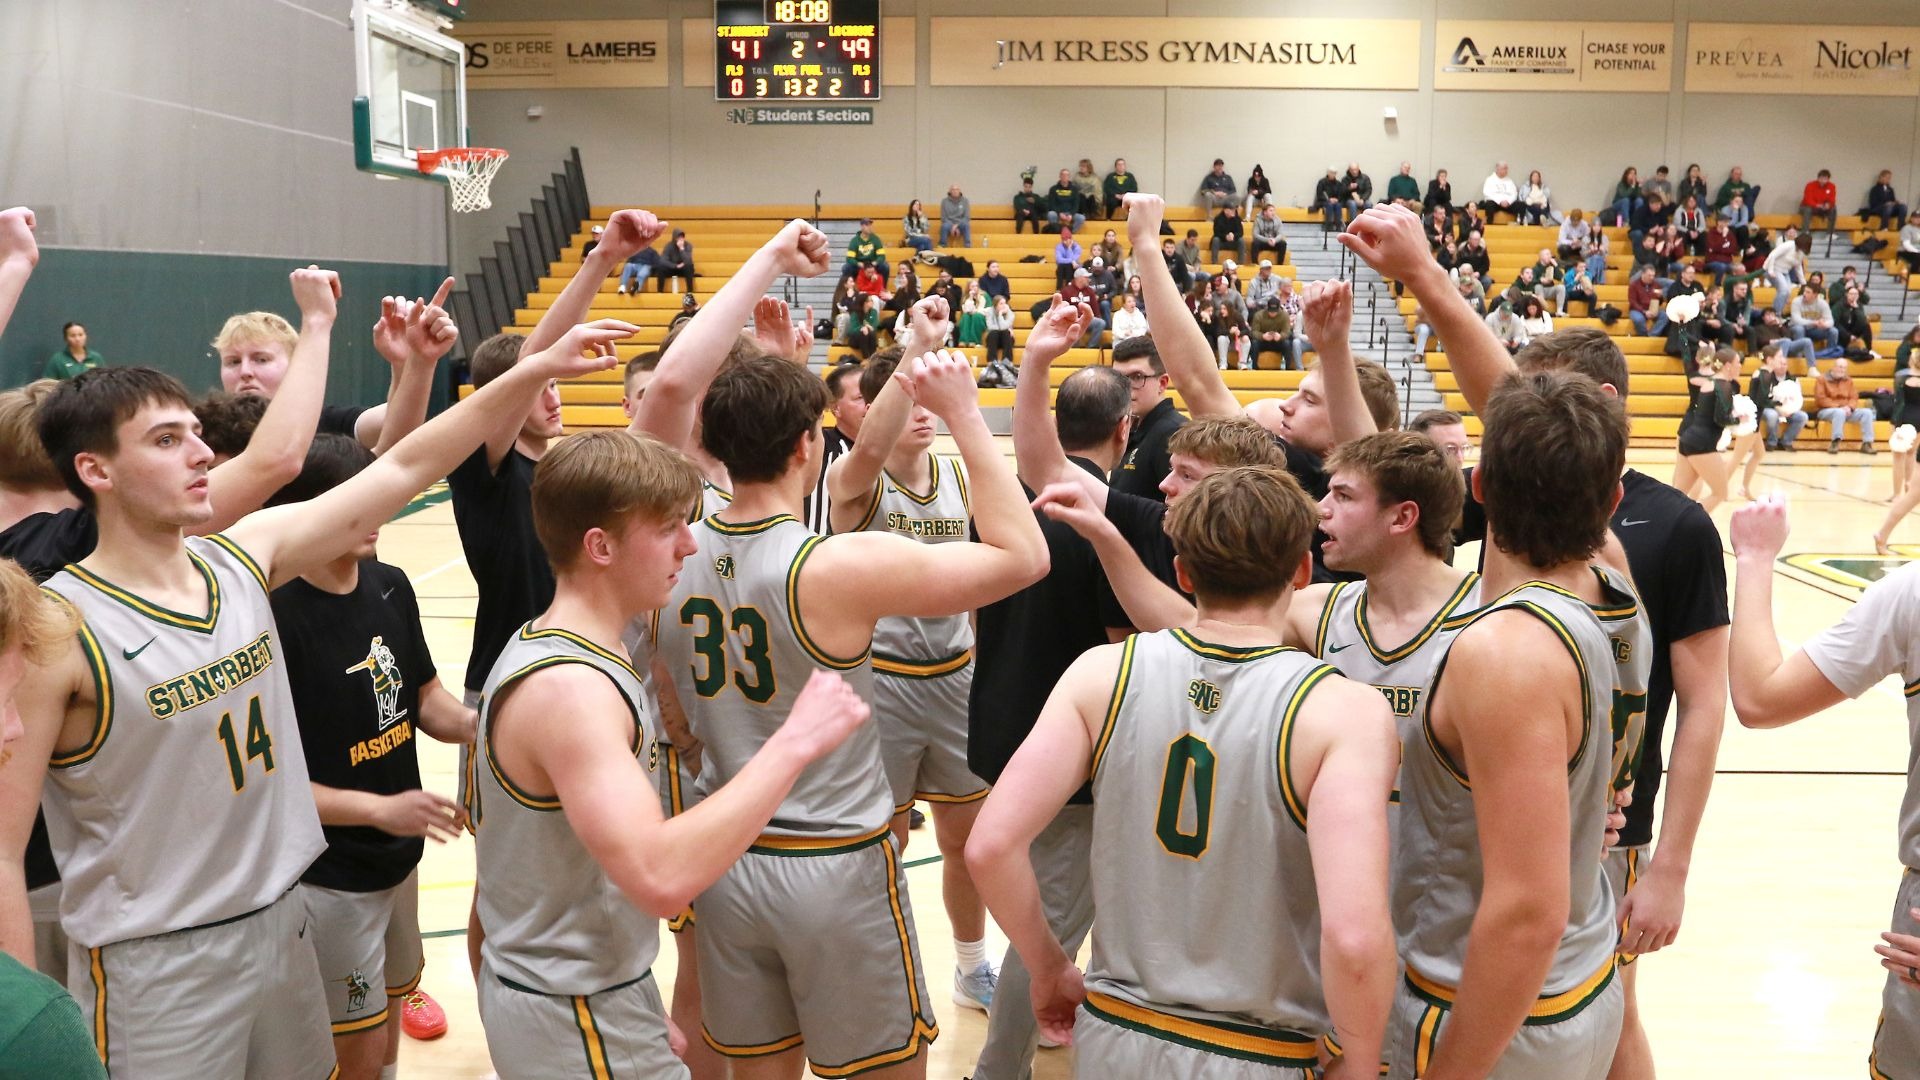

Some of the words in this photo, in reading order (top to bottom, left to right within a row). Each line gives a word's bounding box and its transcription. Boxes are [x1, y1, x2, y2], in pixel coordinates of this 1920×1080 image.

[775, 0, 829, 22] 18:08
[493, 42, 513, 55] DE
[516, 41, 553, 54] PERE
[567, 42, 656, 57] LAMERS
[731, 40, 760, 59] 41
[791, 40, 804, 58] 2
[842, 38, 870, 58] 49
[990, 40, 1044, 70] JIM
[1054, 40, 1149, 62] KRESS
[1159, 41, 1357, 65] GYMNASIUM
[1492, 46, 1567, 59] AMERILUX
[1587, 43, 1628, 54] CHASE
[1632, 43, 1665, 54] YOUR
[1815, 39, 1912, 70] Nicolet
[1594, 59, 1656, 70] POTENTIAL
[1696, 51, 1783, 67] PREVEA
[731, 79, 743, 96] 0
[756, 79, 768, 96] 3
[805, 79, 819, 96] 2
[829, 79, 842, 96] 2
[864, 79, 871, 95] 1
[757, 110, 813, 122] Student
[816, 110, 870, 122] Section
[680, 597, 776, 704] 33
[1187, 679, 1221, 714] SNC
[217, 692, 276, 796] 14
[1155, 732, 1218, 862] 0
